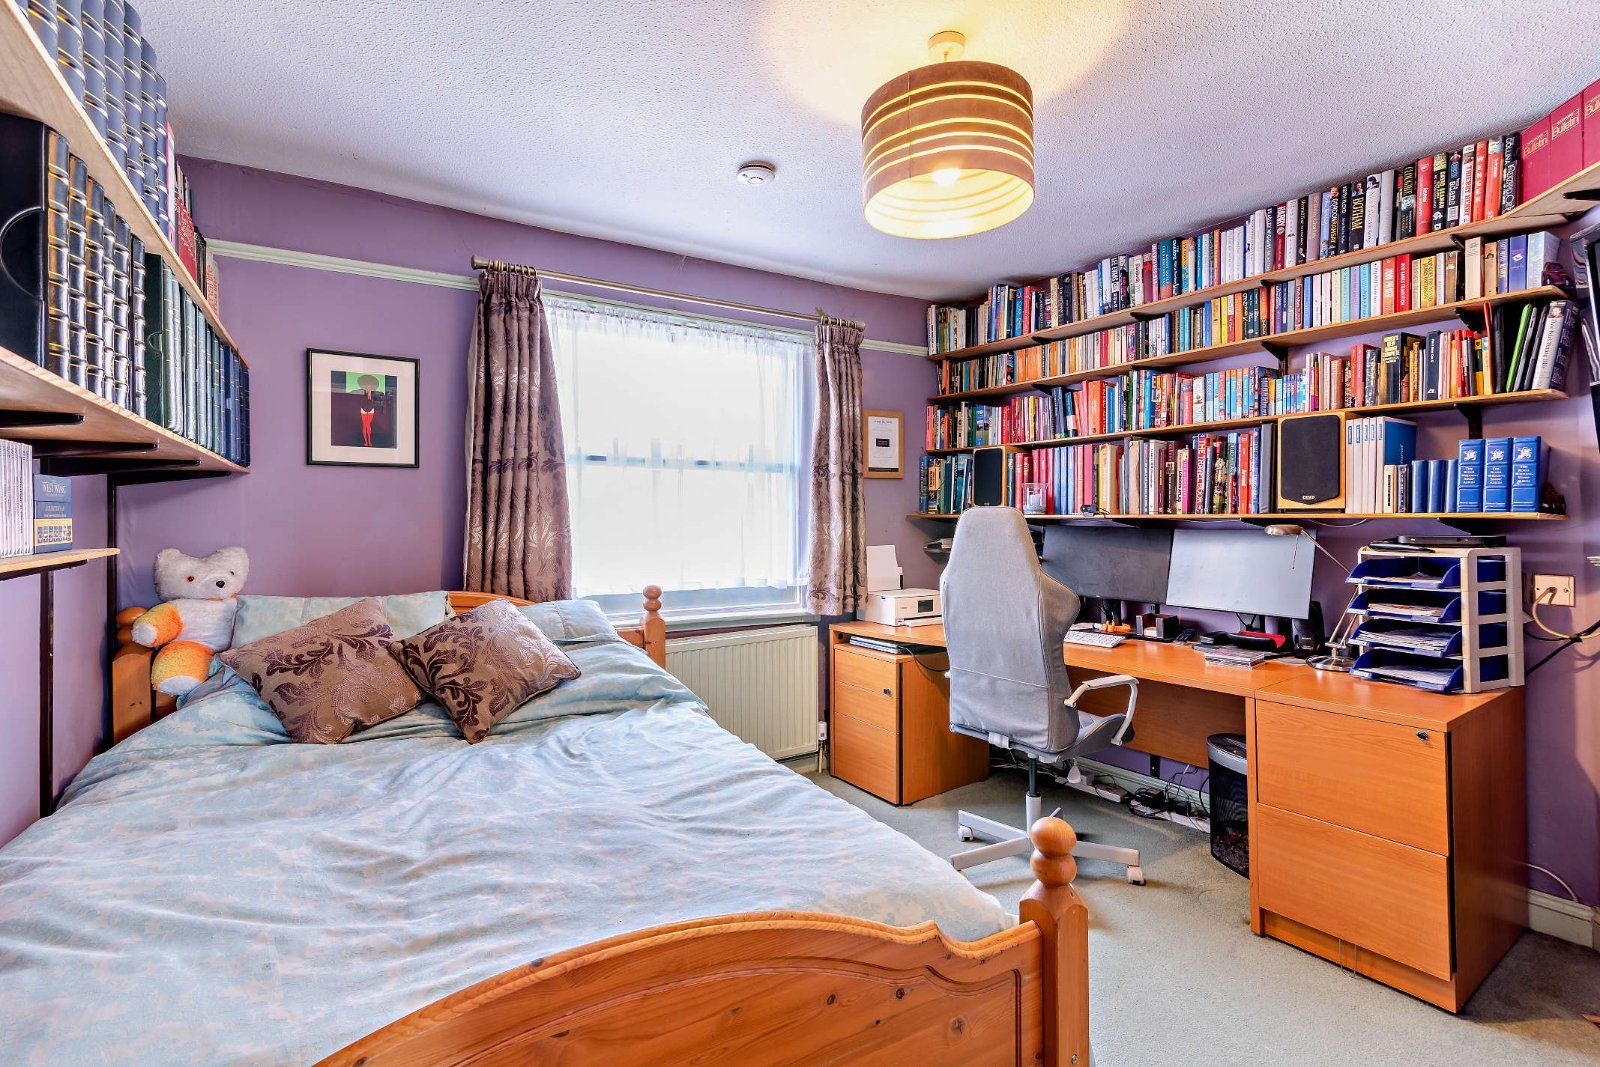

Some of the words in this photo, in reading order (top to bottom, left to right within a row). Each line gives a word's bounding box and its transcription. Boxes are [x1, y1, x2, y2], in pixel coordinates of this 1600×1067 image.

[1552, 115, 1579, 139] Bulletin
[1504, 137, 1514, 165] COLLINA
[1464, 165, 1473, 194] THIERRY
[1475, 155, 1484, 203] WENGER
[1449, 181, 1459, 206] adams
[1463, 195, 1472, 217] HENRY
[1352, 197, 1364, 231] BOTHAM
[1198, 439, 1206, 454] THE
[1196, 455, 1205, 483] TRAVEL
[1195, 483, 1204, 504] BOOK
